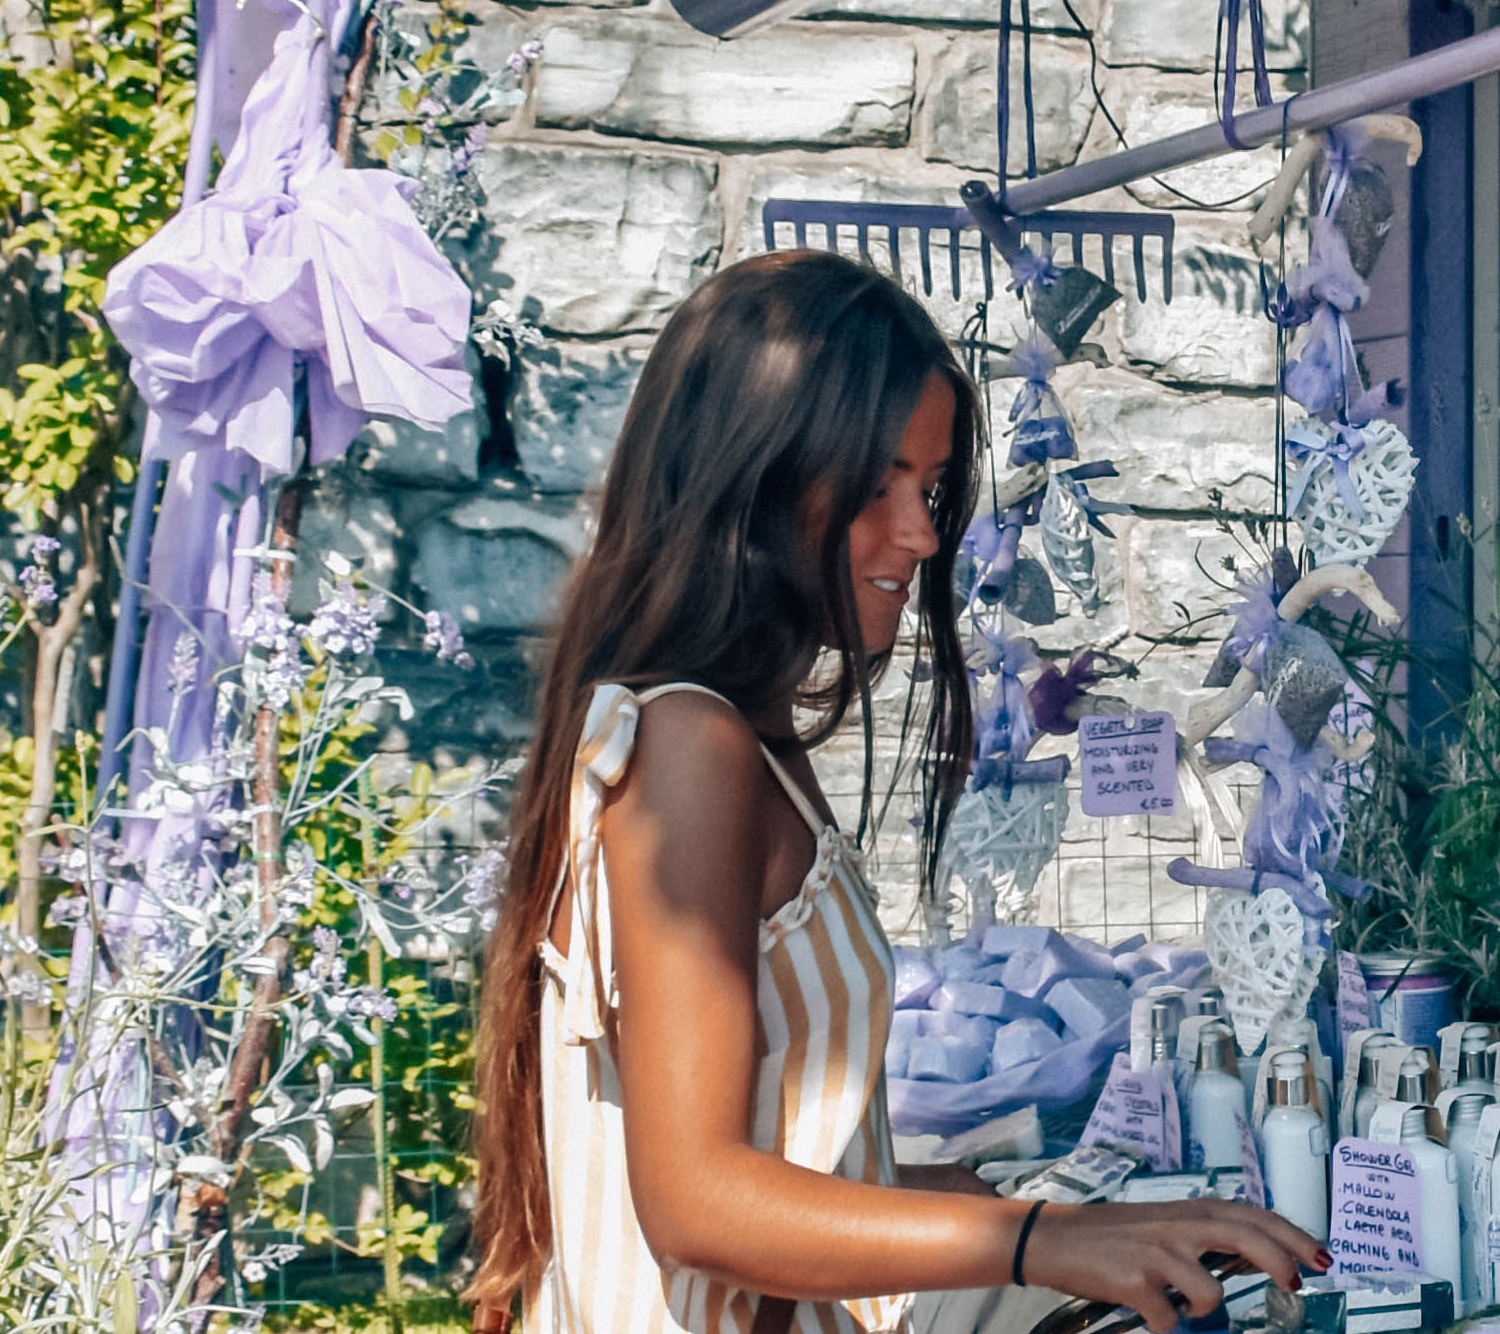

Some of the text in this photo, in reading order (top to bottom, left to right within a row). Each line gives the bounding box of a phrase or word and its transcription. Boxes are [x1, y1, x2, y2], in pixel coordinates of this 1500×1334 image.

[1098, 779, 1154, 795] SCENTED
[1339, 1146, 1414, 1173] SHOWER GEL
[1330, 1238, 1419, 1267] CALMING AND
